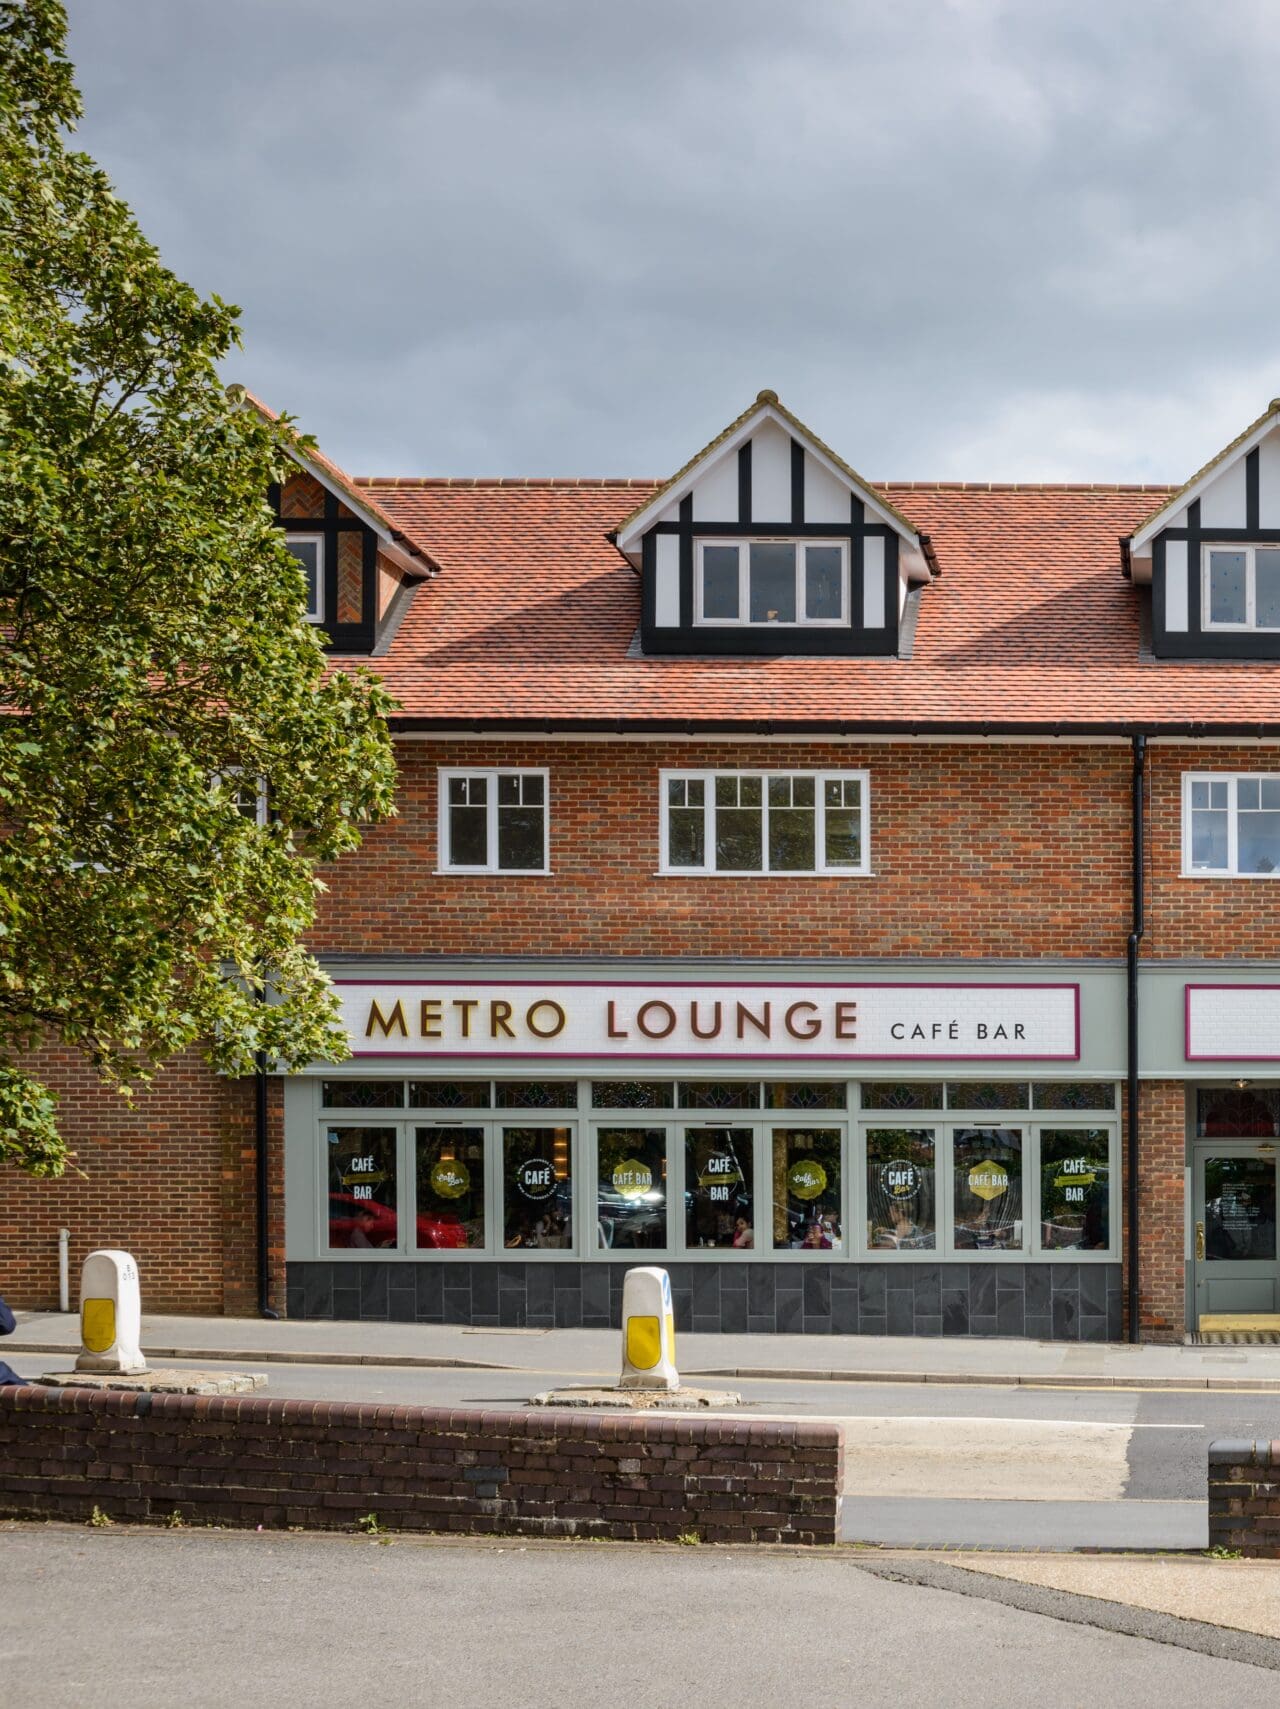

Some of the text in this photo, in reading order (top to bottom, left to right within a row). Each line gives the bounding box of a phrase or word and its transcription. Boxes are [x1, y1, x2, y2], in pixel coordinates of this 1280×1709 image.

[365, 999, 857, 1040] METRO LOUNGE
[890, 1019, 1026, 1040] CAFÉ BAR
[351, 1155, 374, 1172] CAFÉ
[708, 1156, 731, 1173] CAFÉ
[1063, 1157, 1086, 1173] CAFÉ
[525, 1167, 550, 1185] CAFÉ
[612, 1170, 652, 1185] CAFÉ BAR
[888, 1168, 914, 1185] CAFÉ
[968, 1171, 1008, 1186] CAFÉ BAR
[353, 1185, 372, 1200] BAR
[710, 1186, 729, 1201] BAR
[1065, 1187, 1084, 1201] BAR
